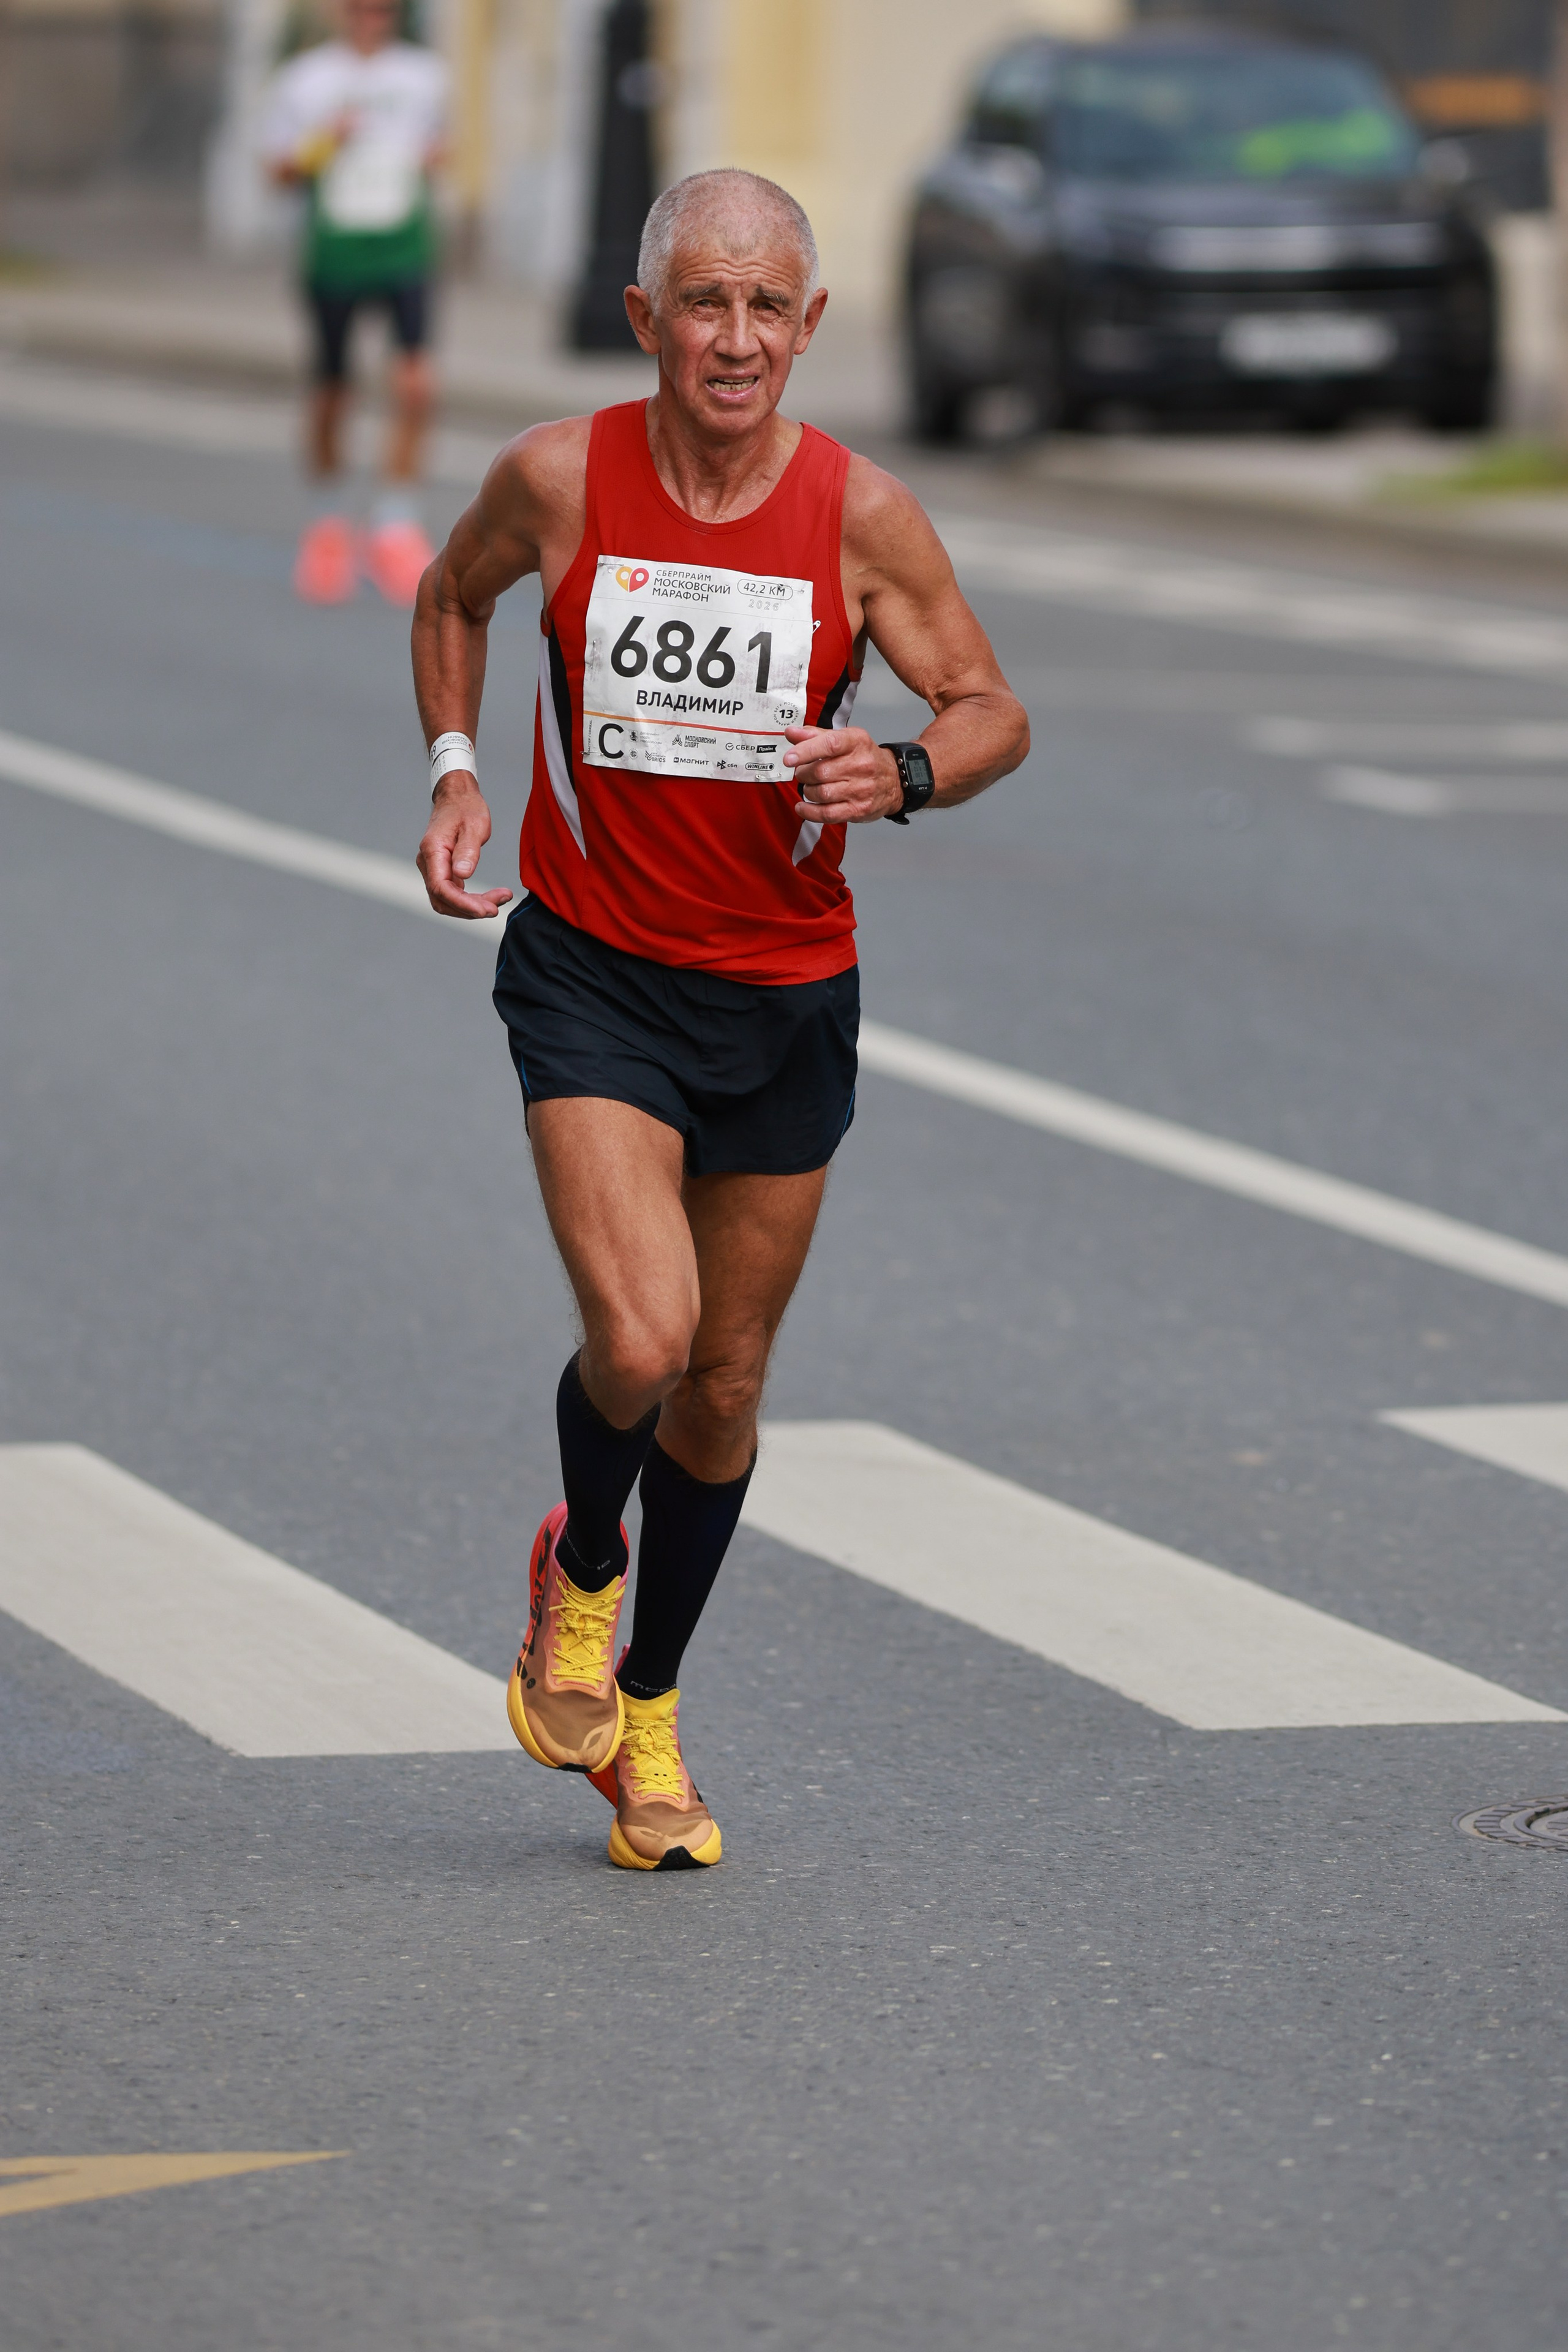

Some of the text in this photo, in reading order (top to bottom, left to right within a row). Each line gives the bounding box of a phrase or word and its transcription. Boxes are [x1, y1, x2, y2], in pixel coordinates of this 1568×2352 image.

[656, 570, 712, 581] СБЕРПРАЙМ
[654, 578, 731, 594] МОСКОВСКИЙ
[744, 582, 766, 594] 42,2
[652, 587, 709, 602] МАРАФОН
[748, 599, 779, 611] 2026
[611, 616, 772, 693] 6861
[636, 690, 744, 715] ВЛАДИМИР
[779, 709, 794, 718] 13
[685, 735, 717, 744] МОСКОВСКИЙ
